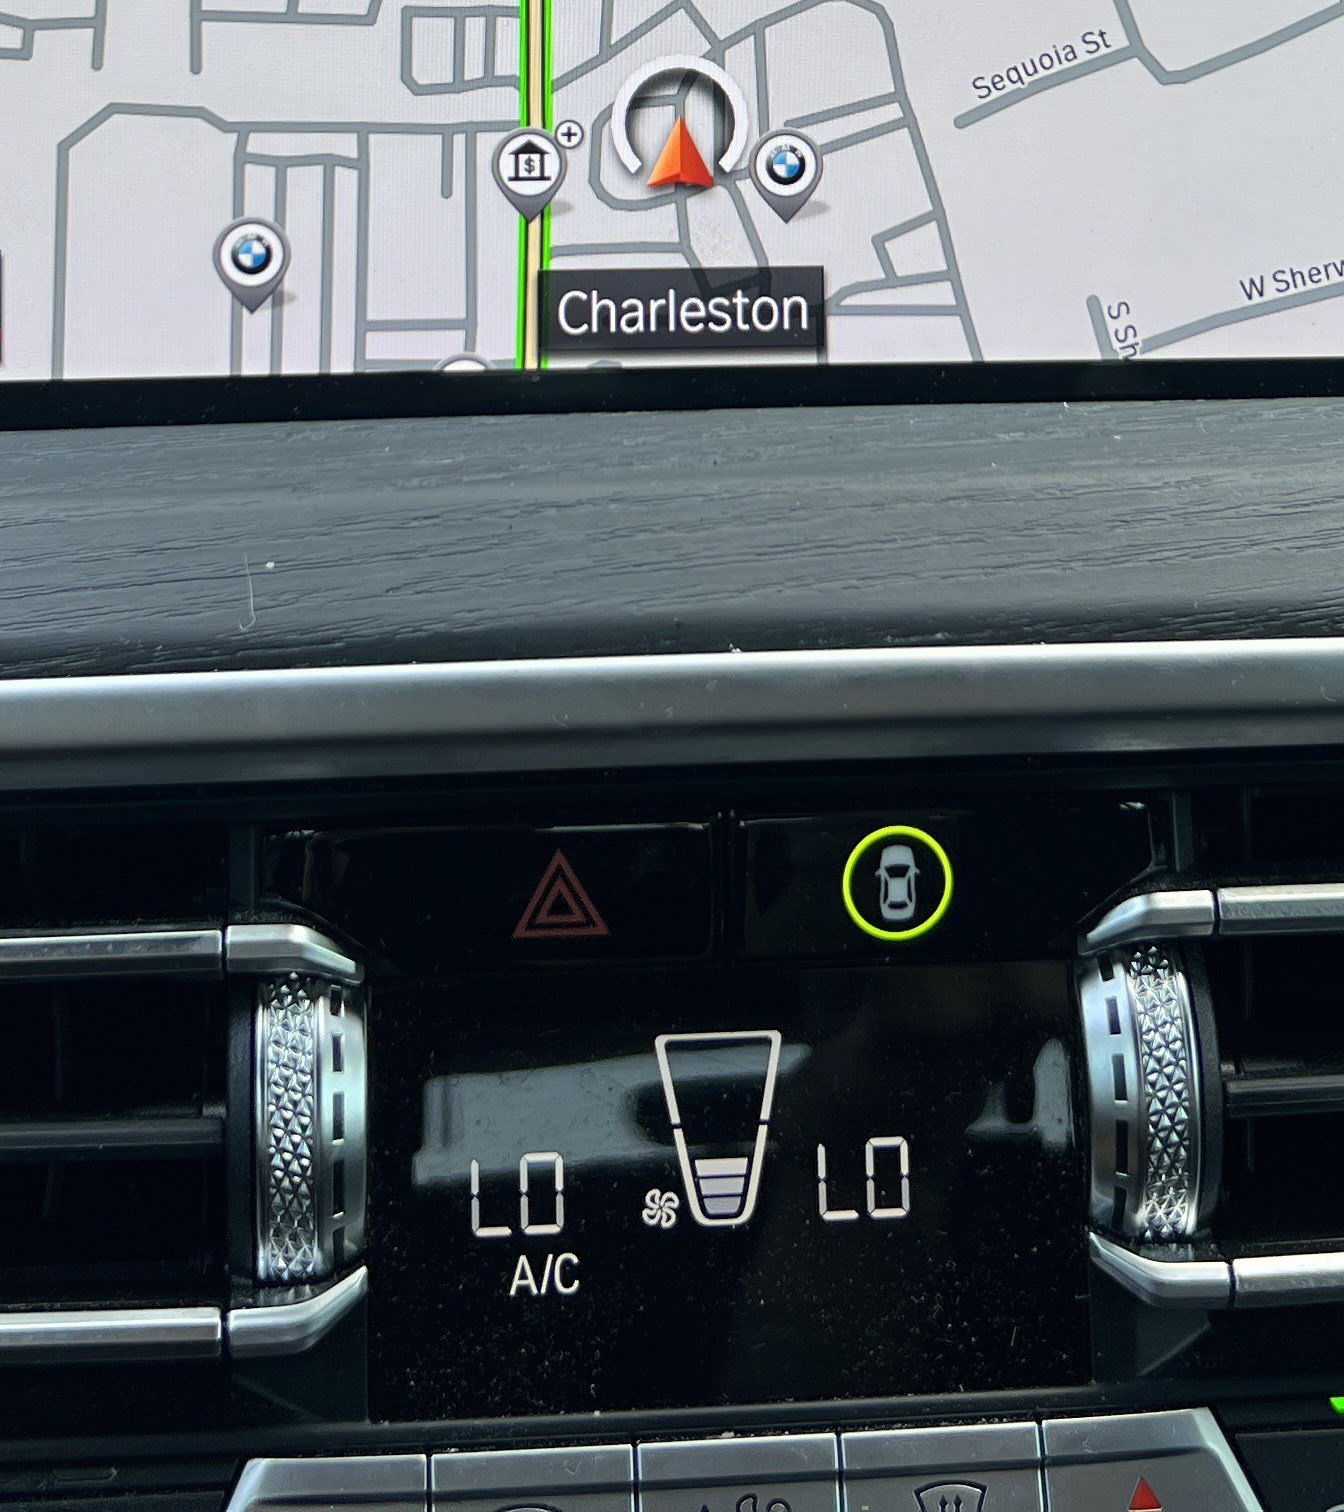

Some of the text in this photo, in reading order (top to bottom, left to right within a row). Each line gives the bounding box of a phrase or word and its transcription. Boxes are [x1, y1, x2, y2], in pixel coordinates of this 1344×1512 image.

[971, 28, 1112, 100] Sequoia St
[1238, 273, 1265, 302] W
[558, 288, 809, 335] Charleston
[1107, 301, 1130, 320] S
[509, 1252, 581, 1297] A/C
